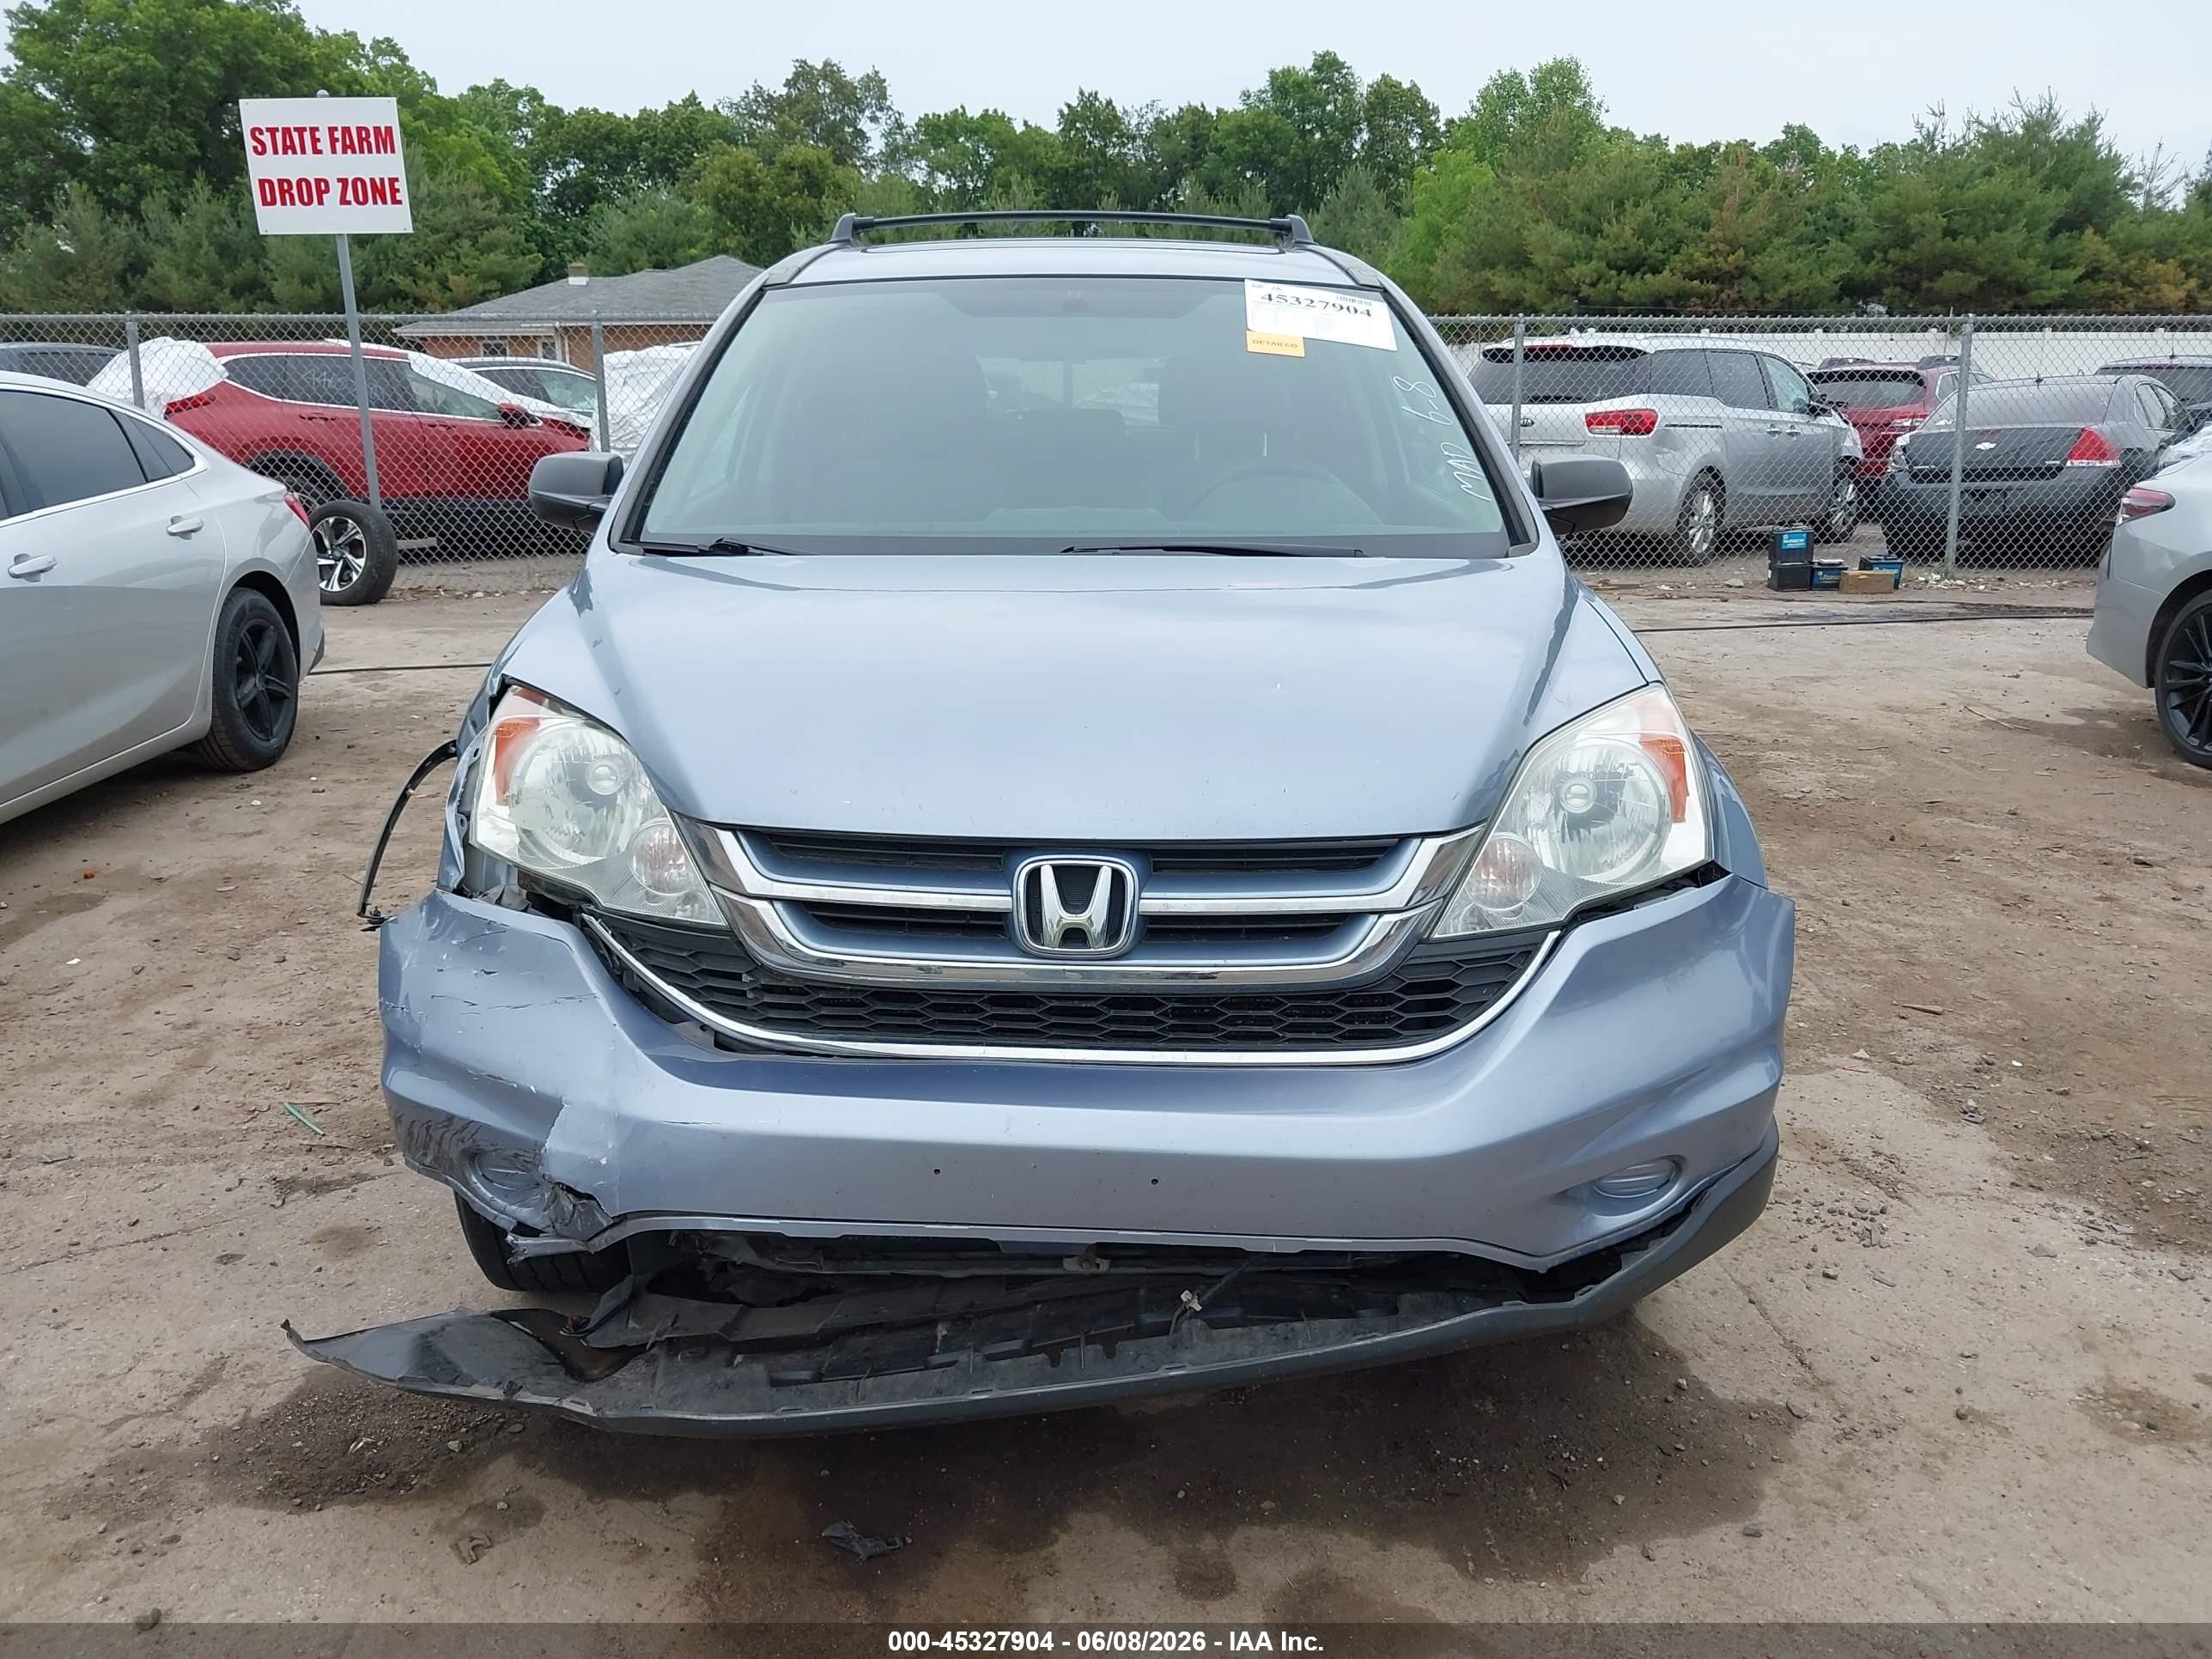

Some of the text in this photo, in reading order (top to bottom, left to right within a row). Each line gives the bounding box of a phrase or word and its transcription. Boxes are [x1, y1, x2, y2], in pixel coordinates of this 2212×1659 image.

[249, 125, 396, 156] STATE FARM
[258, 177, 404, 207] DROP ZONE
[1261, 293, 1372, 318] 45327904
[1252, 339, 1298, 349] DETAILED
